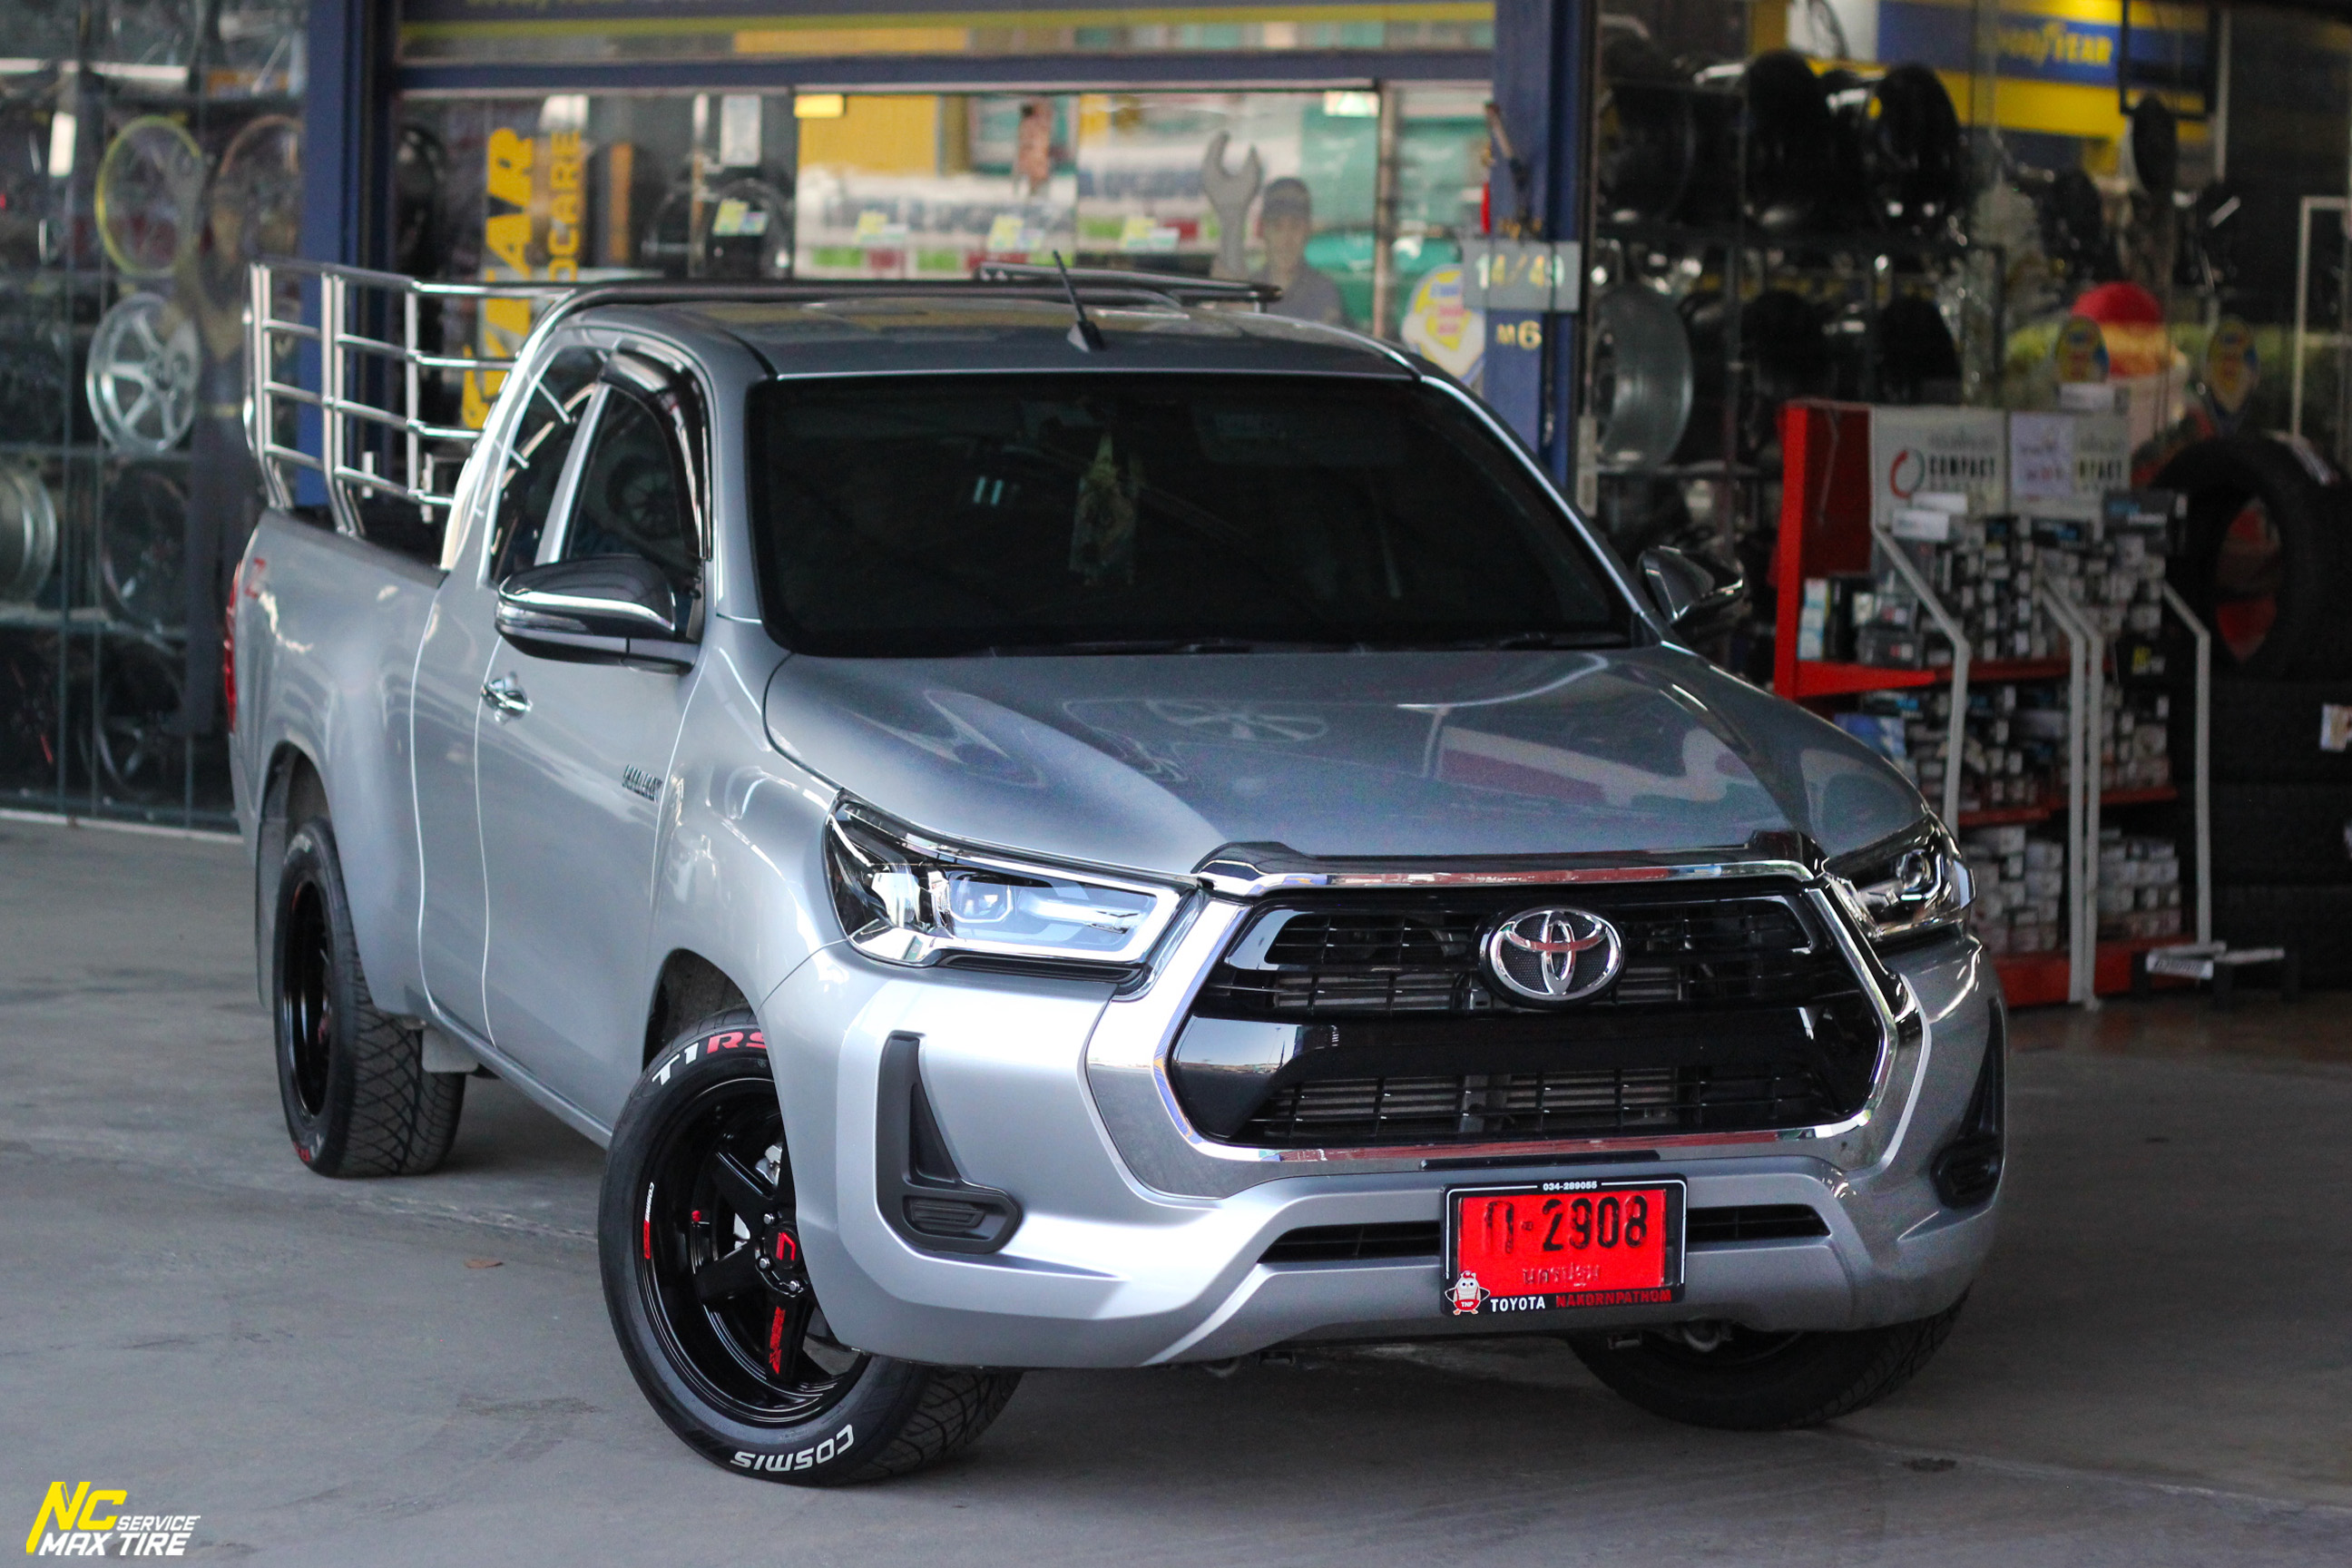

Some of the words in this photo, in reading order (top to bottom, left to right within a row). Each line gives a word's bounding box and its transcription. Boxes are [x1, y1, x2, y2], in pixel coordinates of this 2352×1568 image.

[1543, 1181, 1598, 1191] 034-289055
[1490, 1296, 1545, 1313] TOYOTA
[1555, 1289, 1671, 1308] NAKORNPATHOM
[730, 1424, 855, 1472] COSMIS
